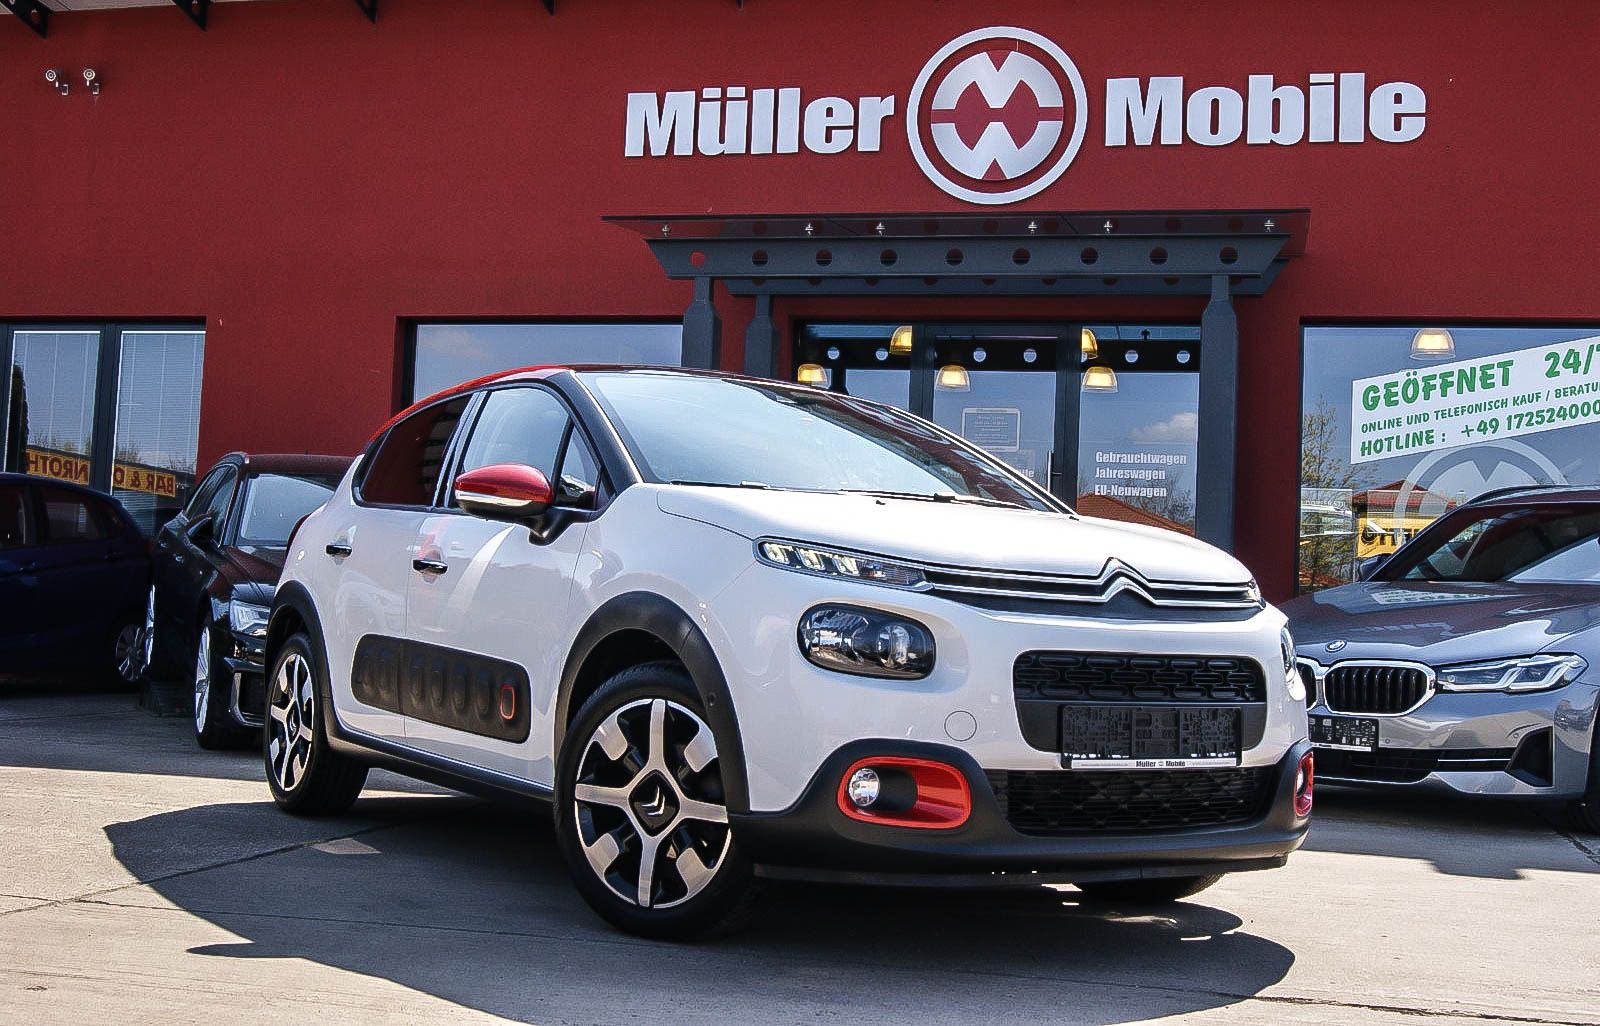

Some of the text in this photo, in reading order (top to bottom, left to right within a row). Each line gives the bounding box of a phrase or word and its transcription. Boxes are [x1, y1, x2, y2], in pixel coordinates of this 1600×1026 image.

[624, 72, 1427, 158] Müller Mobile
[1362, 360, 1515, 411] GEÖFFNET
[1361, 417, 1403, 434] ONLINE
[1406, 412, 1430, 425] UND
[1434, 398, 1508, 420] TELEFONISCH
[1512, 392, 1542, 407] KAUF
[1554, 381, 1600, 398] BERATU
[1360, 429, 1435, 456] HOTLINE
[1461, 417, 1500, 438] +49
[1095, 451, 1187, 465] Gebrauchtwagen
[1095, 467, 1166, 480] Jahreswagen
[1094, 484, 1167, 497] EU-Neuwagen
